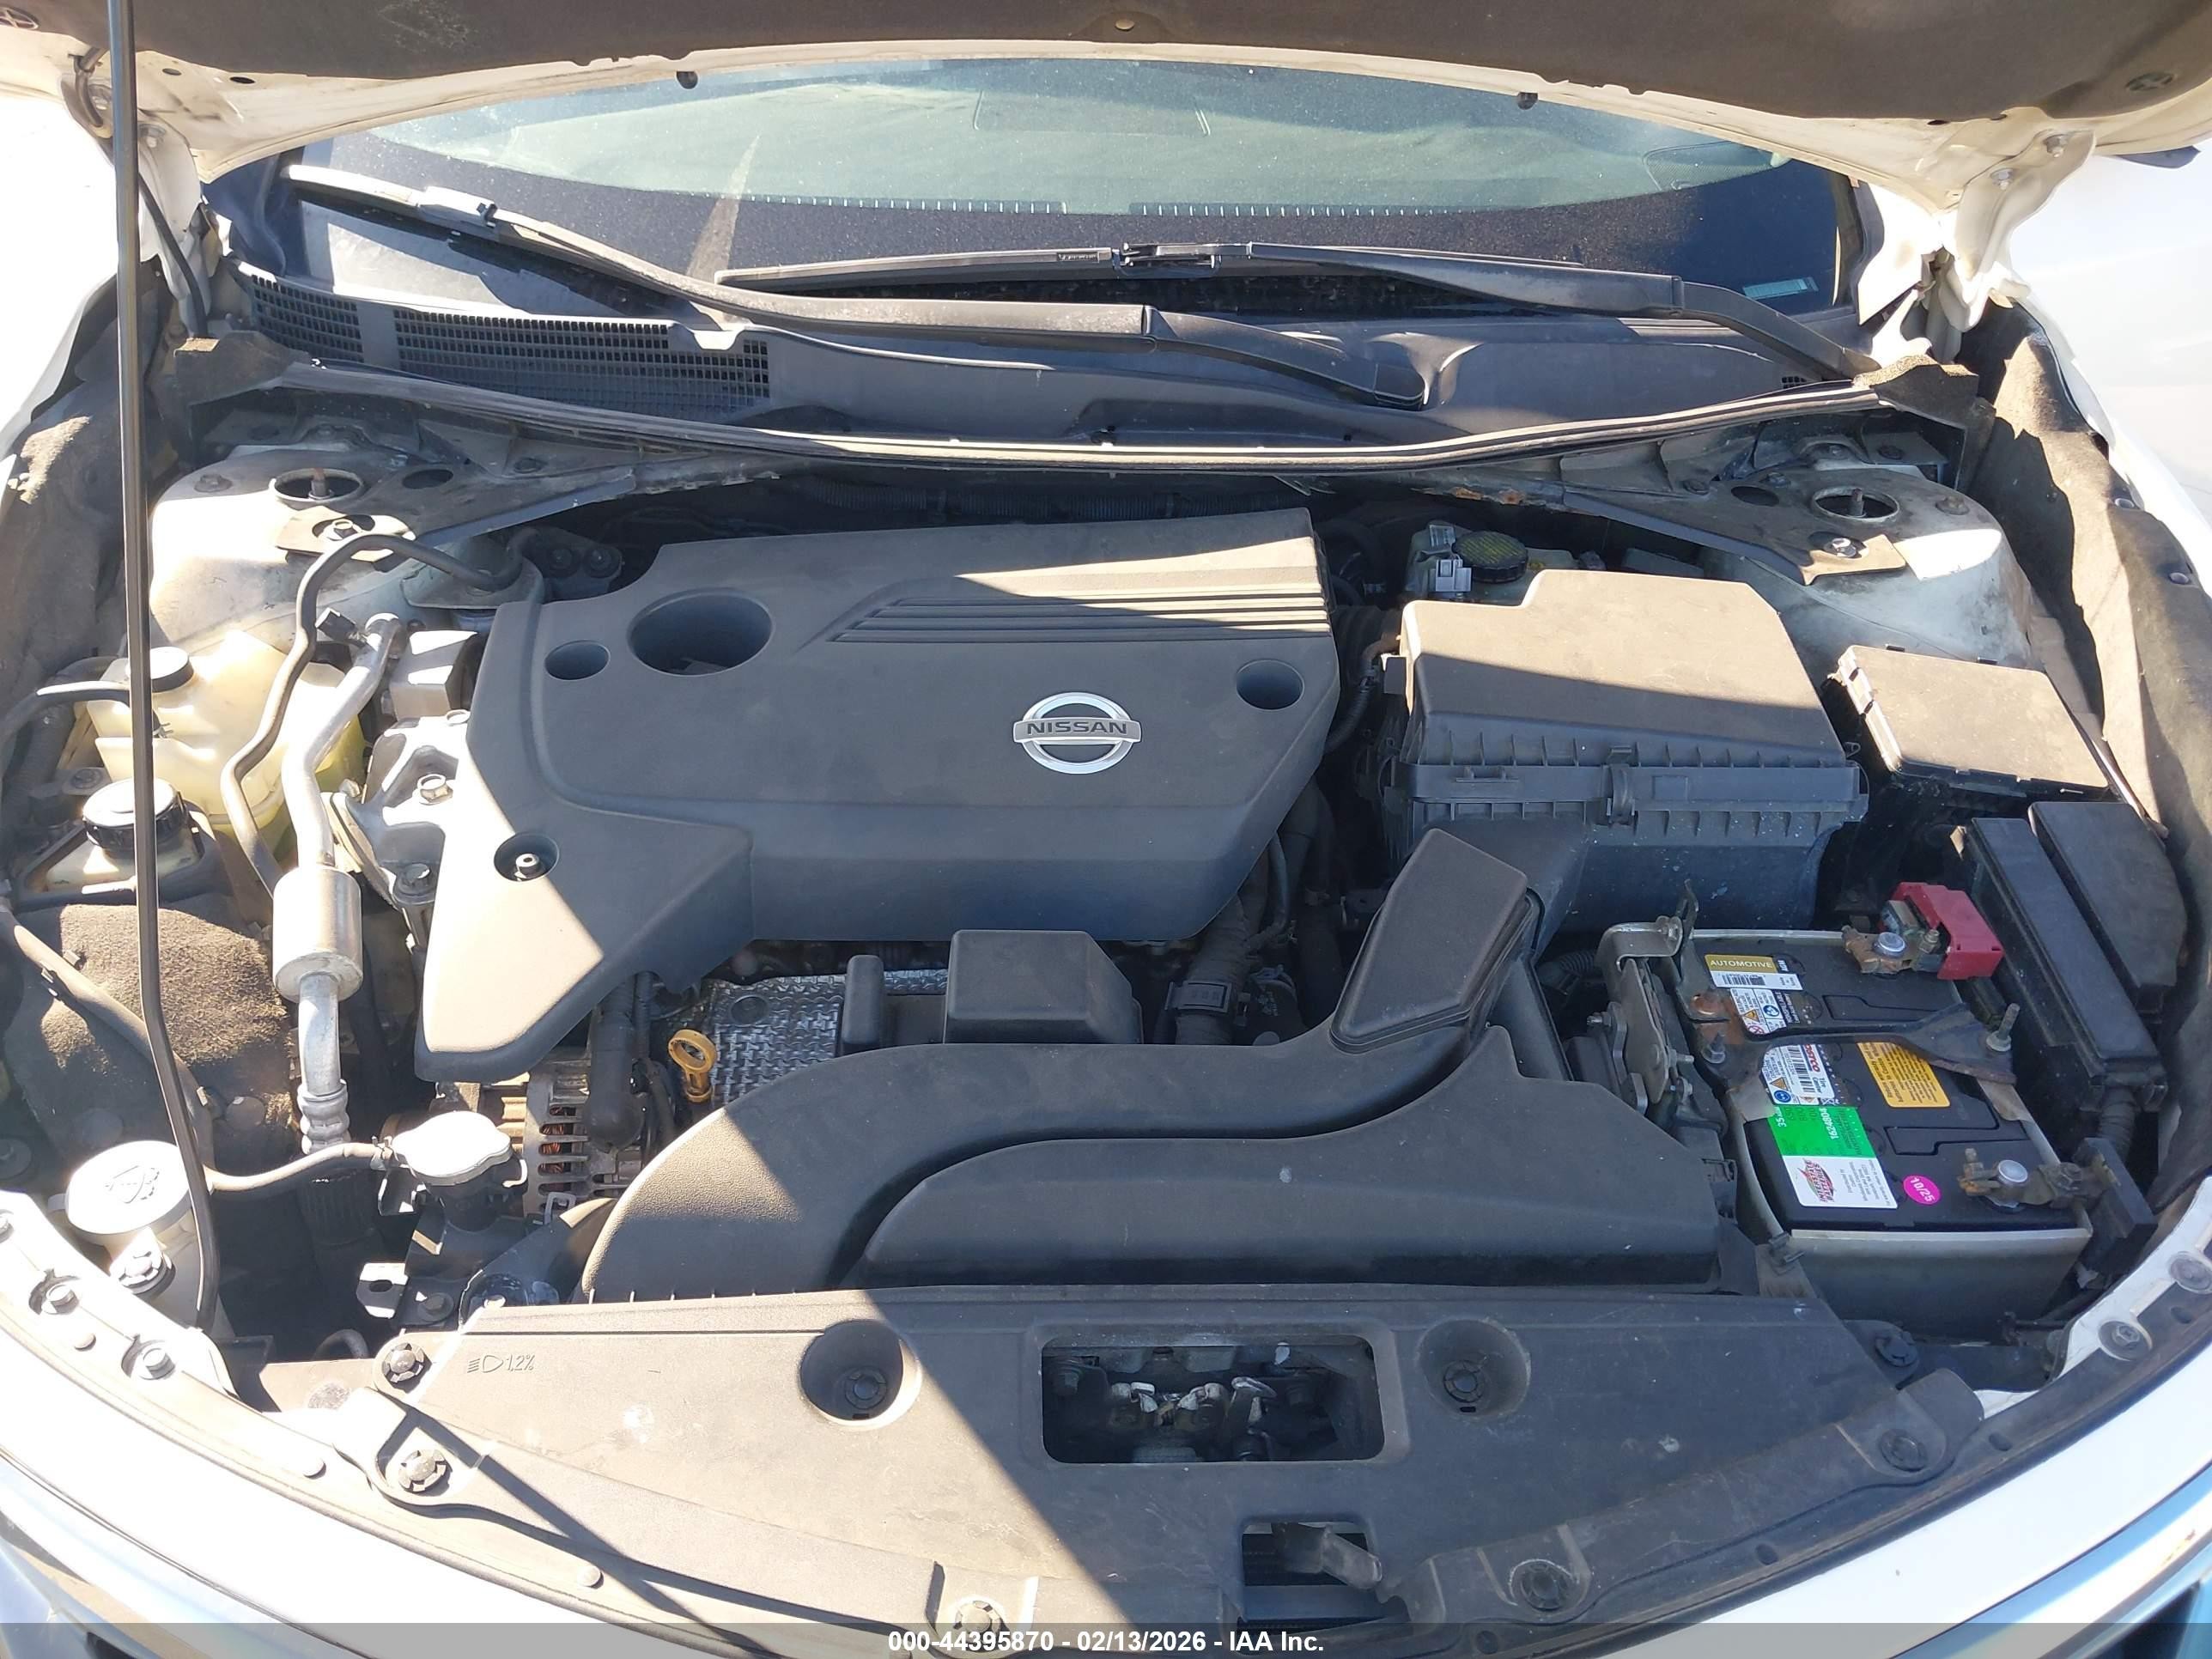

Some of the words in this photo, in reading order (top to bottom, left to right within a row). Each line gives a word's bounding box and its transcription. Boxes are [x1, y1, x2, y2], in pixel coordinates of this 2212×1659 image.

[1027, 721, 1127, 734] NISSAN
[1710, 959, 1773, 969] AUTOMOTIVE
[1804, 1044, 1821, 1073] OSTCO
[1775, 1117, 1787, 1127] 35
[1819, 1107, 1838, 1139] 1624804
[1805, 1159, 1828, 1202] INTERSTATE
[1911, 1177, 1936, 1201] 10/25
